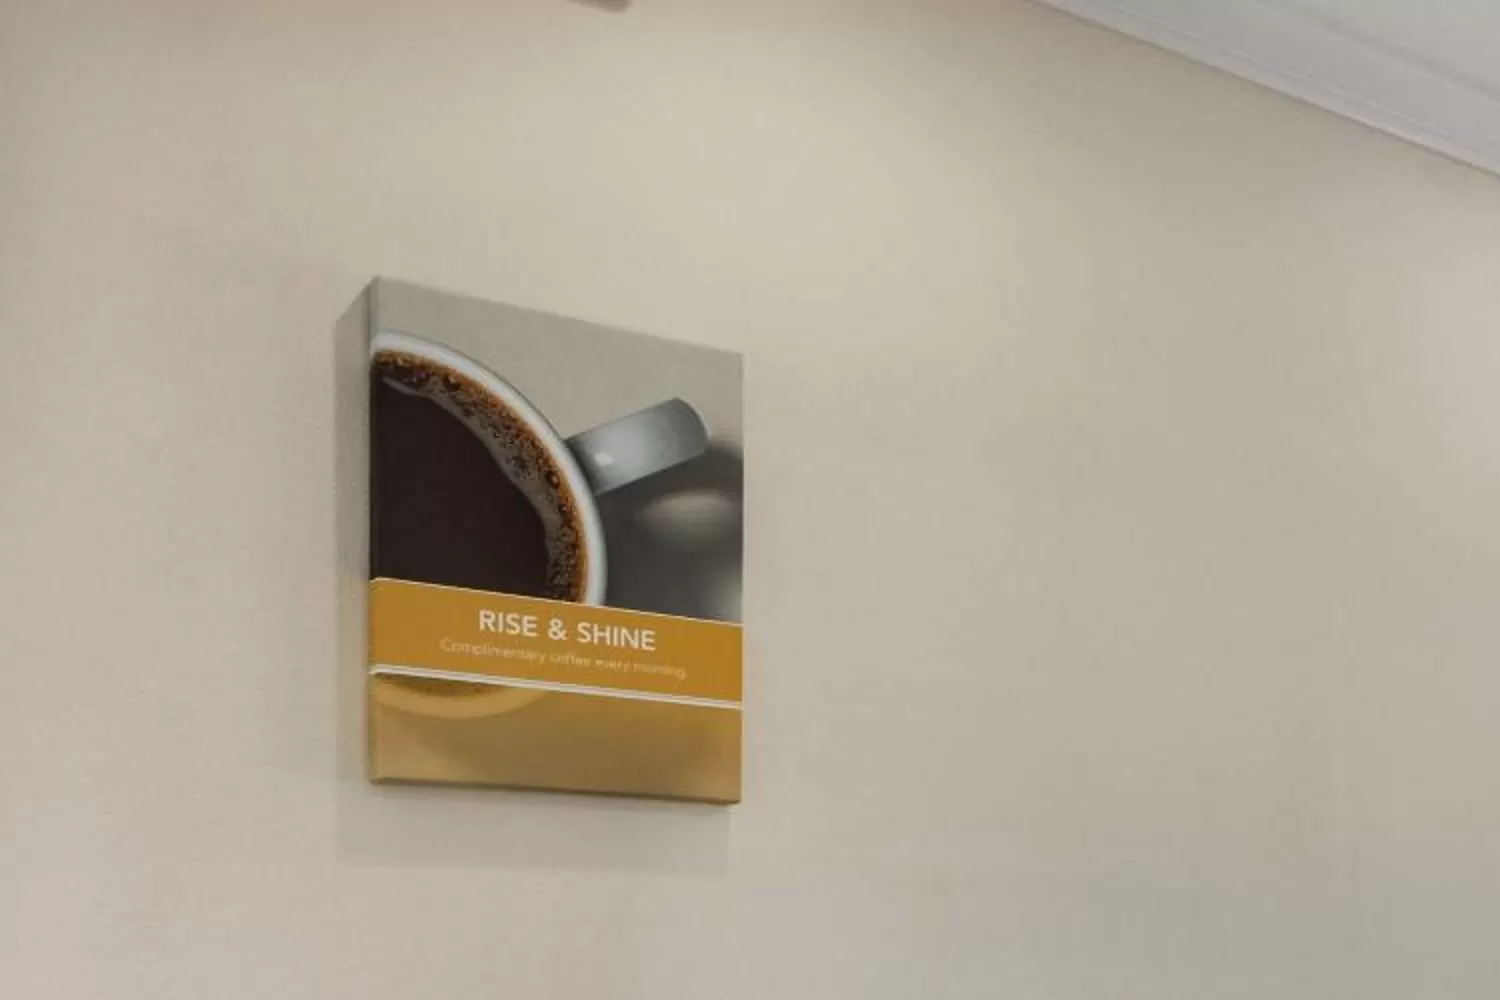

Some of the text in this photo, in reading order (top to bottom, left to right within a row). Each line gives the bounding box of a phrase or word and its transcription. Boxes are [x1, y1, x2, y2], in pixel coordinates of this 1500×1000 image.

[479, 609, 657, 652] RISE & SHINE
[440, 637, 546, 665] Complimentary
[549, 651, 591, 666] coffee
